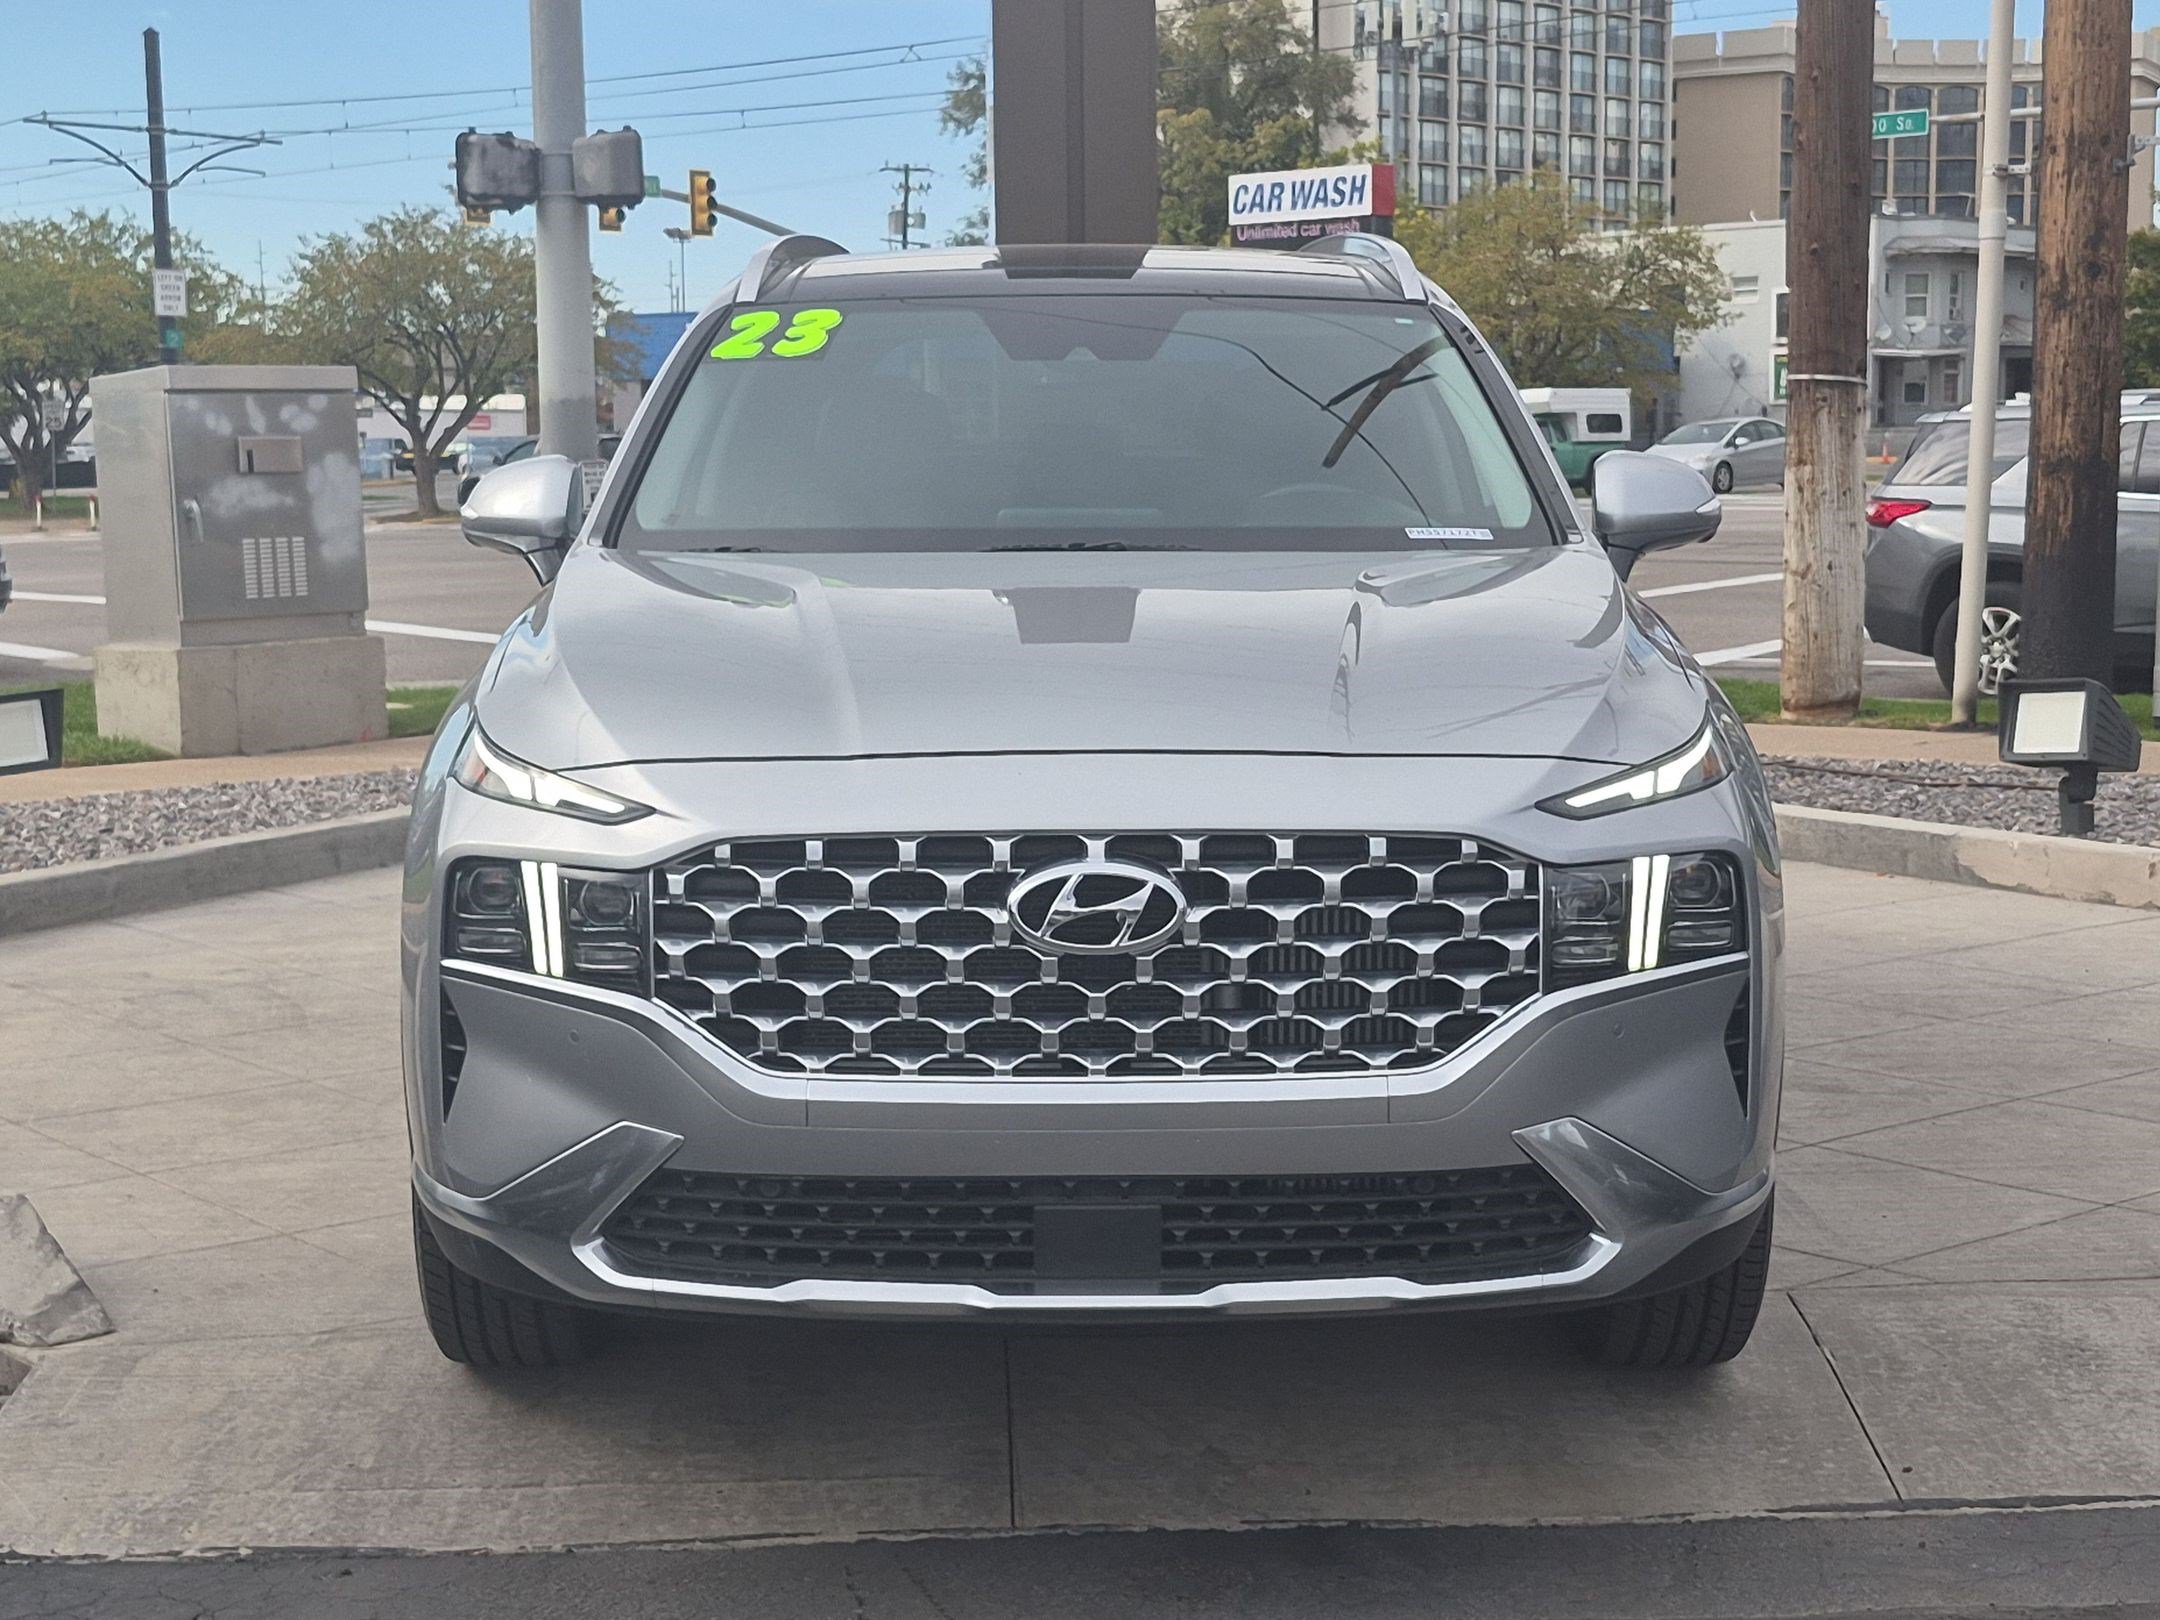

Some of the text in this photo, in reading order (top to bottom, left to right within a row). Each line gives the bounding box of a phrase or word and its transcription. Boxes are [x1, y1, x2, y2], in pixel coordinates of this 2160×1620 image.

[1232, 173, 1368, 215] CAR WASH
[1236, 219, 1361, 241] Unlimited car wash
[710, 308, 843, 360] 23
